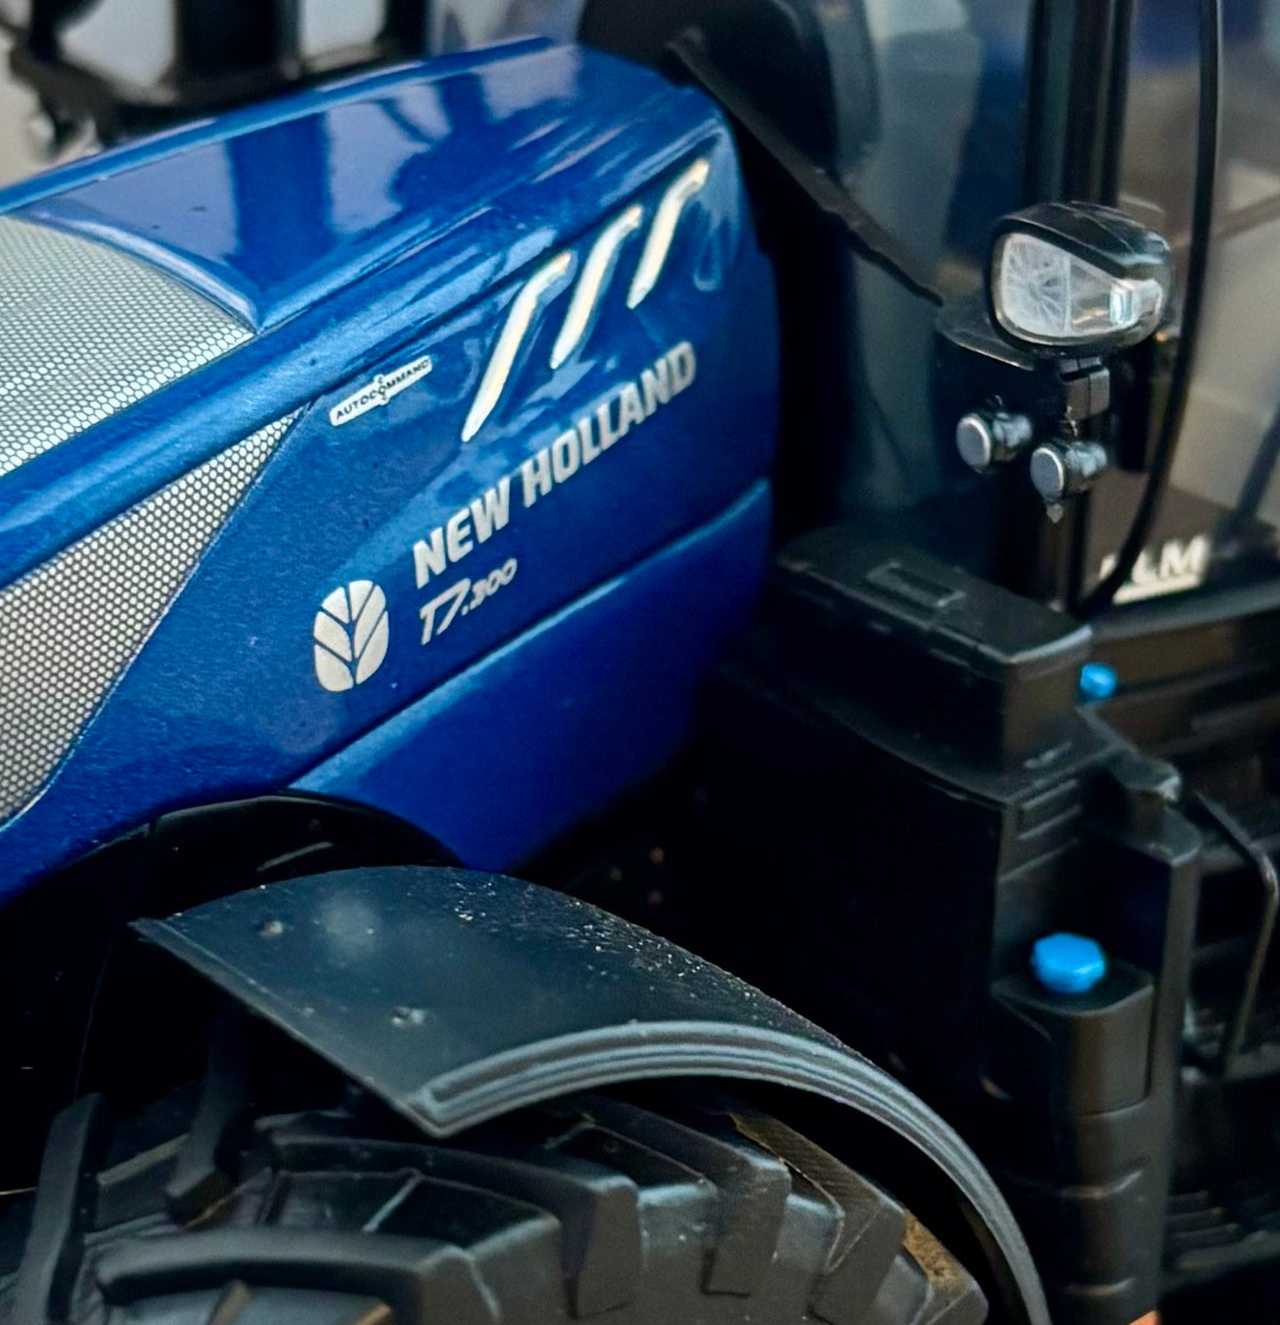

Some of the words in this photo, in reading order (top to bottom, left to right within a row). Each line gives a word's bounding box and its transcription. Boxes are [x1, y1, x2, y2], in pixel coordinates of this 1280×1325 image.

[336, 359, 430, 420] AUTOCOMMAND
[413, 475, 511, 589] NEW
[520, 341, 697, 508] HOLLAND
[419, 557, 518, 646] T7.300
